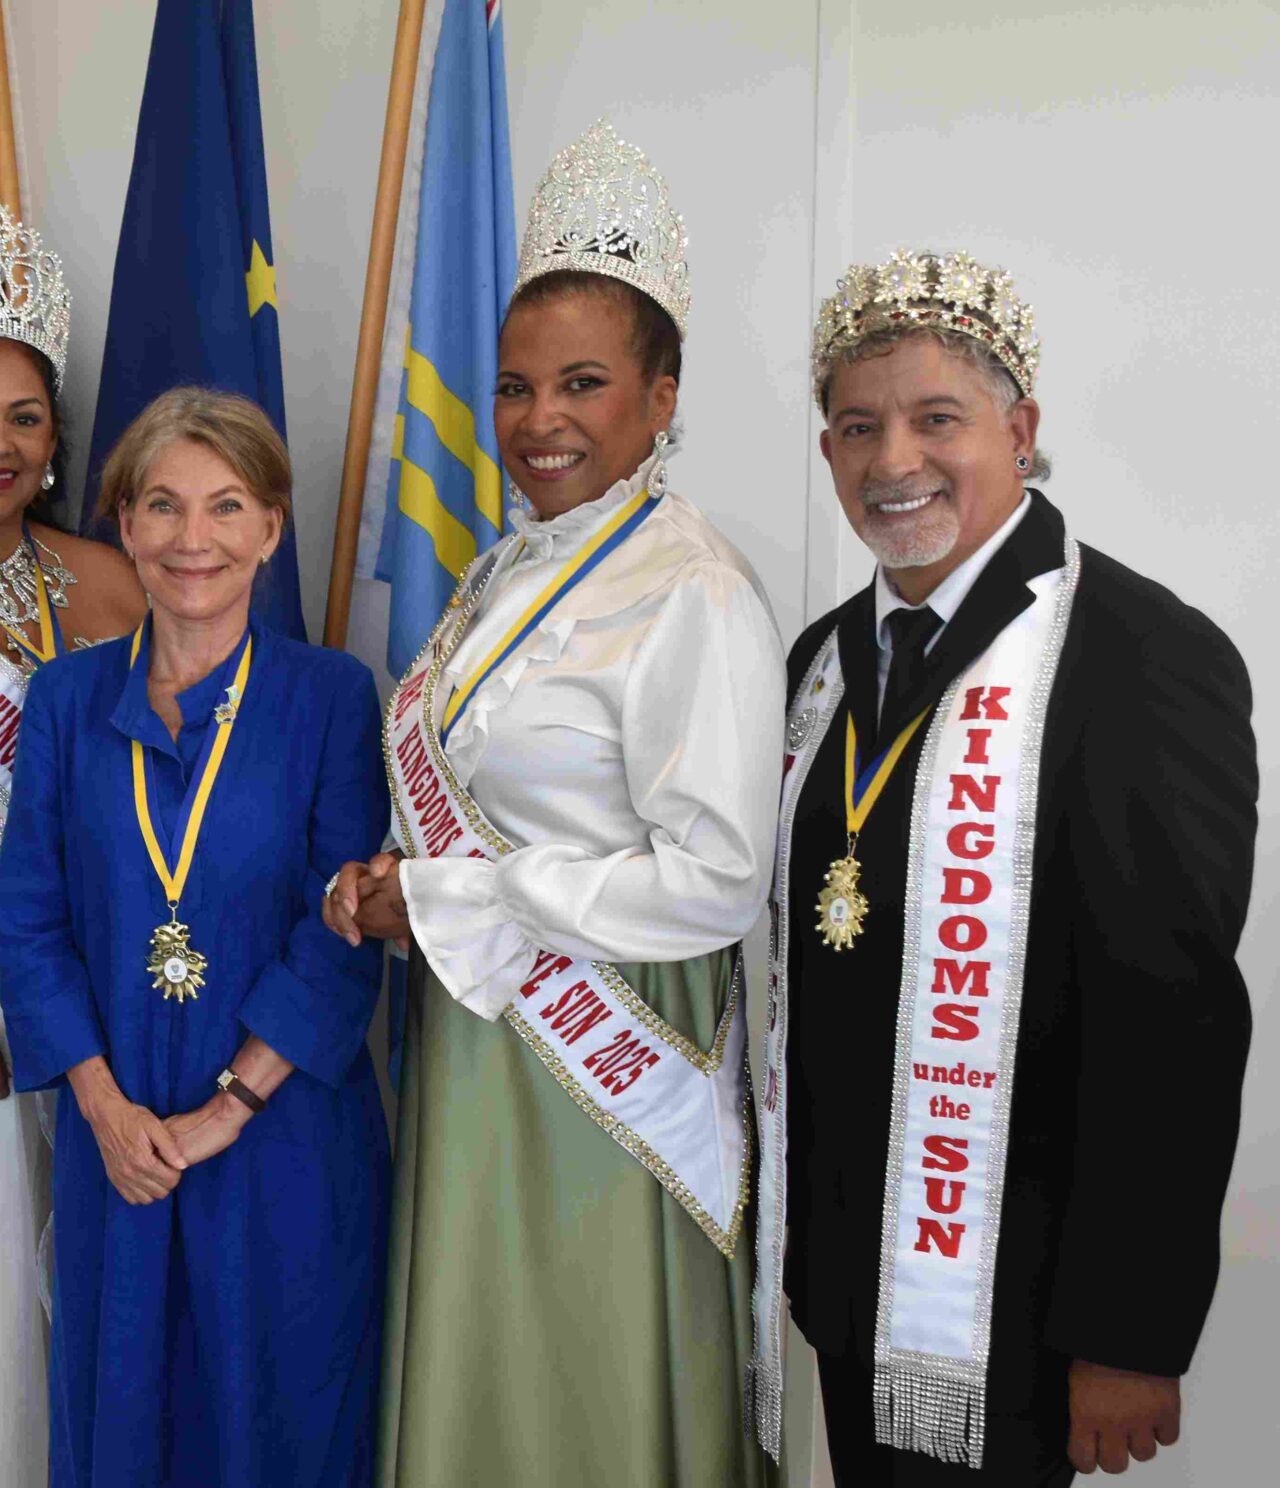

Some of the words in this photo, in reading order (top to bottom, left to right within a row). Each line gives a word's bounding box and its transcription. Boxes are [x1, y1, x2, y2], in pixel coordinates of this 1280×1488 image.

[396, 721, 464, 859] KINGDOMS
[930, 686, 1012, 1042] KINGDOMS
[538, 980, 613, 1047] SUN
[582, 1028, 661, 1097] 2025
[912, 1062, 997, 1089] under
[928, 1094, 971, 1121] the
[913, 1134, 970, 1259] SUN
